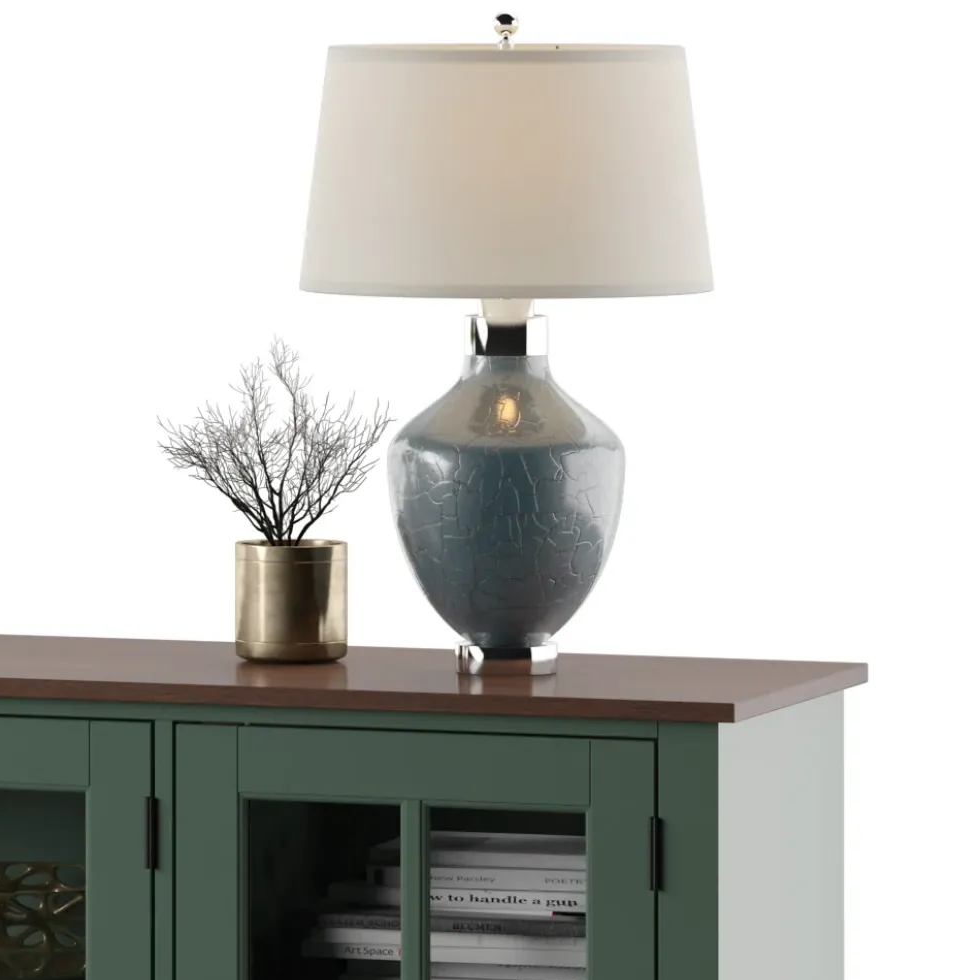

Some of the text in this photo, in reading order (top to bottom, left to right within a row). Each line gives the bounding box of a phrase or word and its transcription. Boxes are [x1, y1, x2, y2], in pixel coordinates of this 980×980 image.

[469, 895, 527, 905] handle
[344, 947, 393, 956] Art Space
